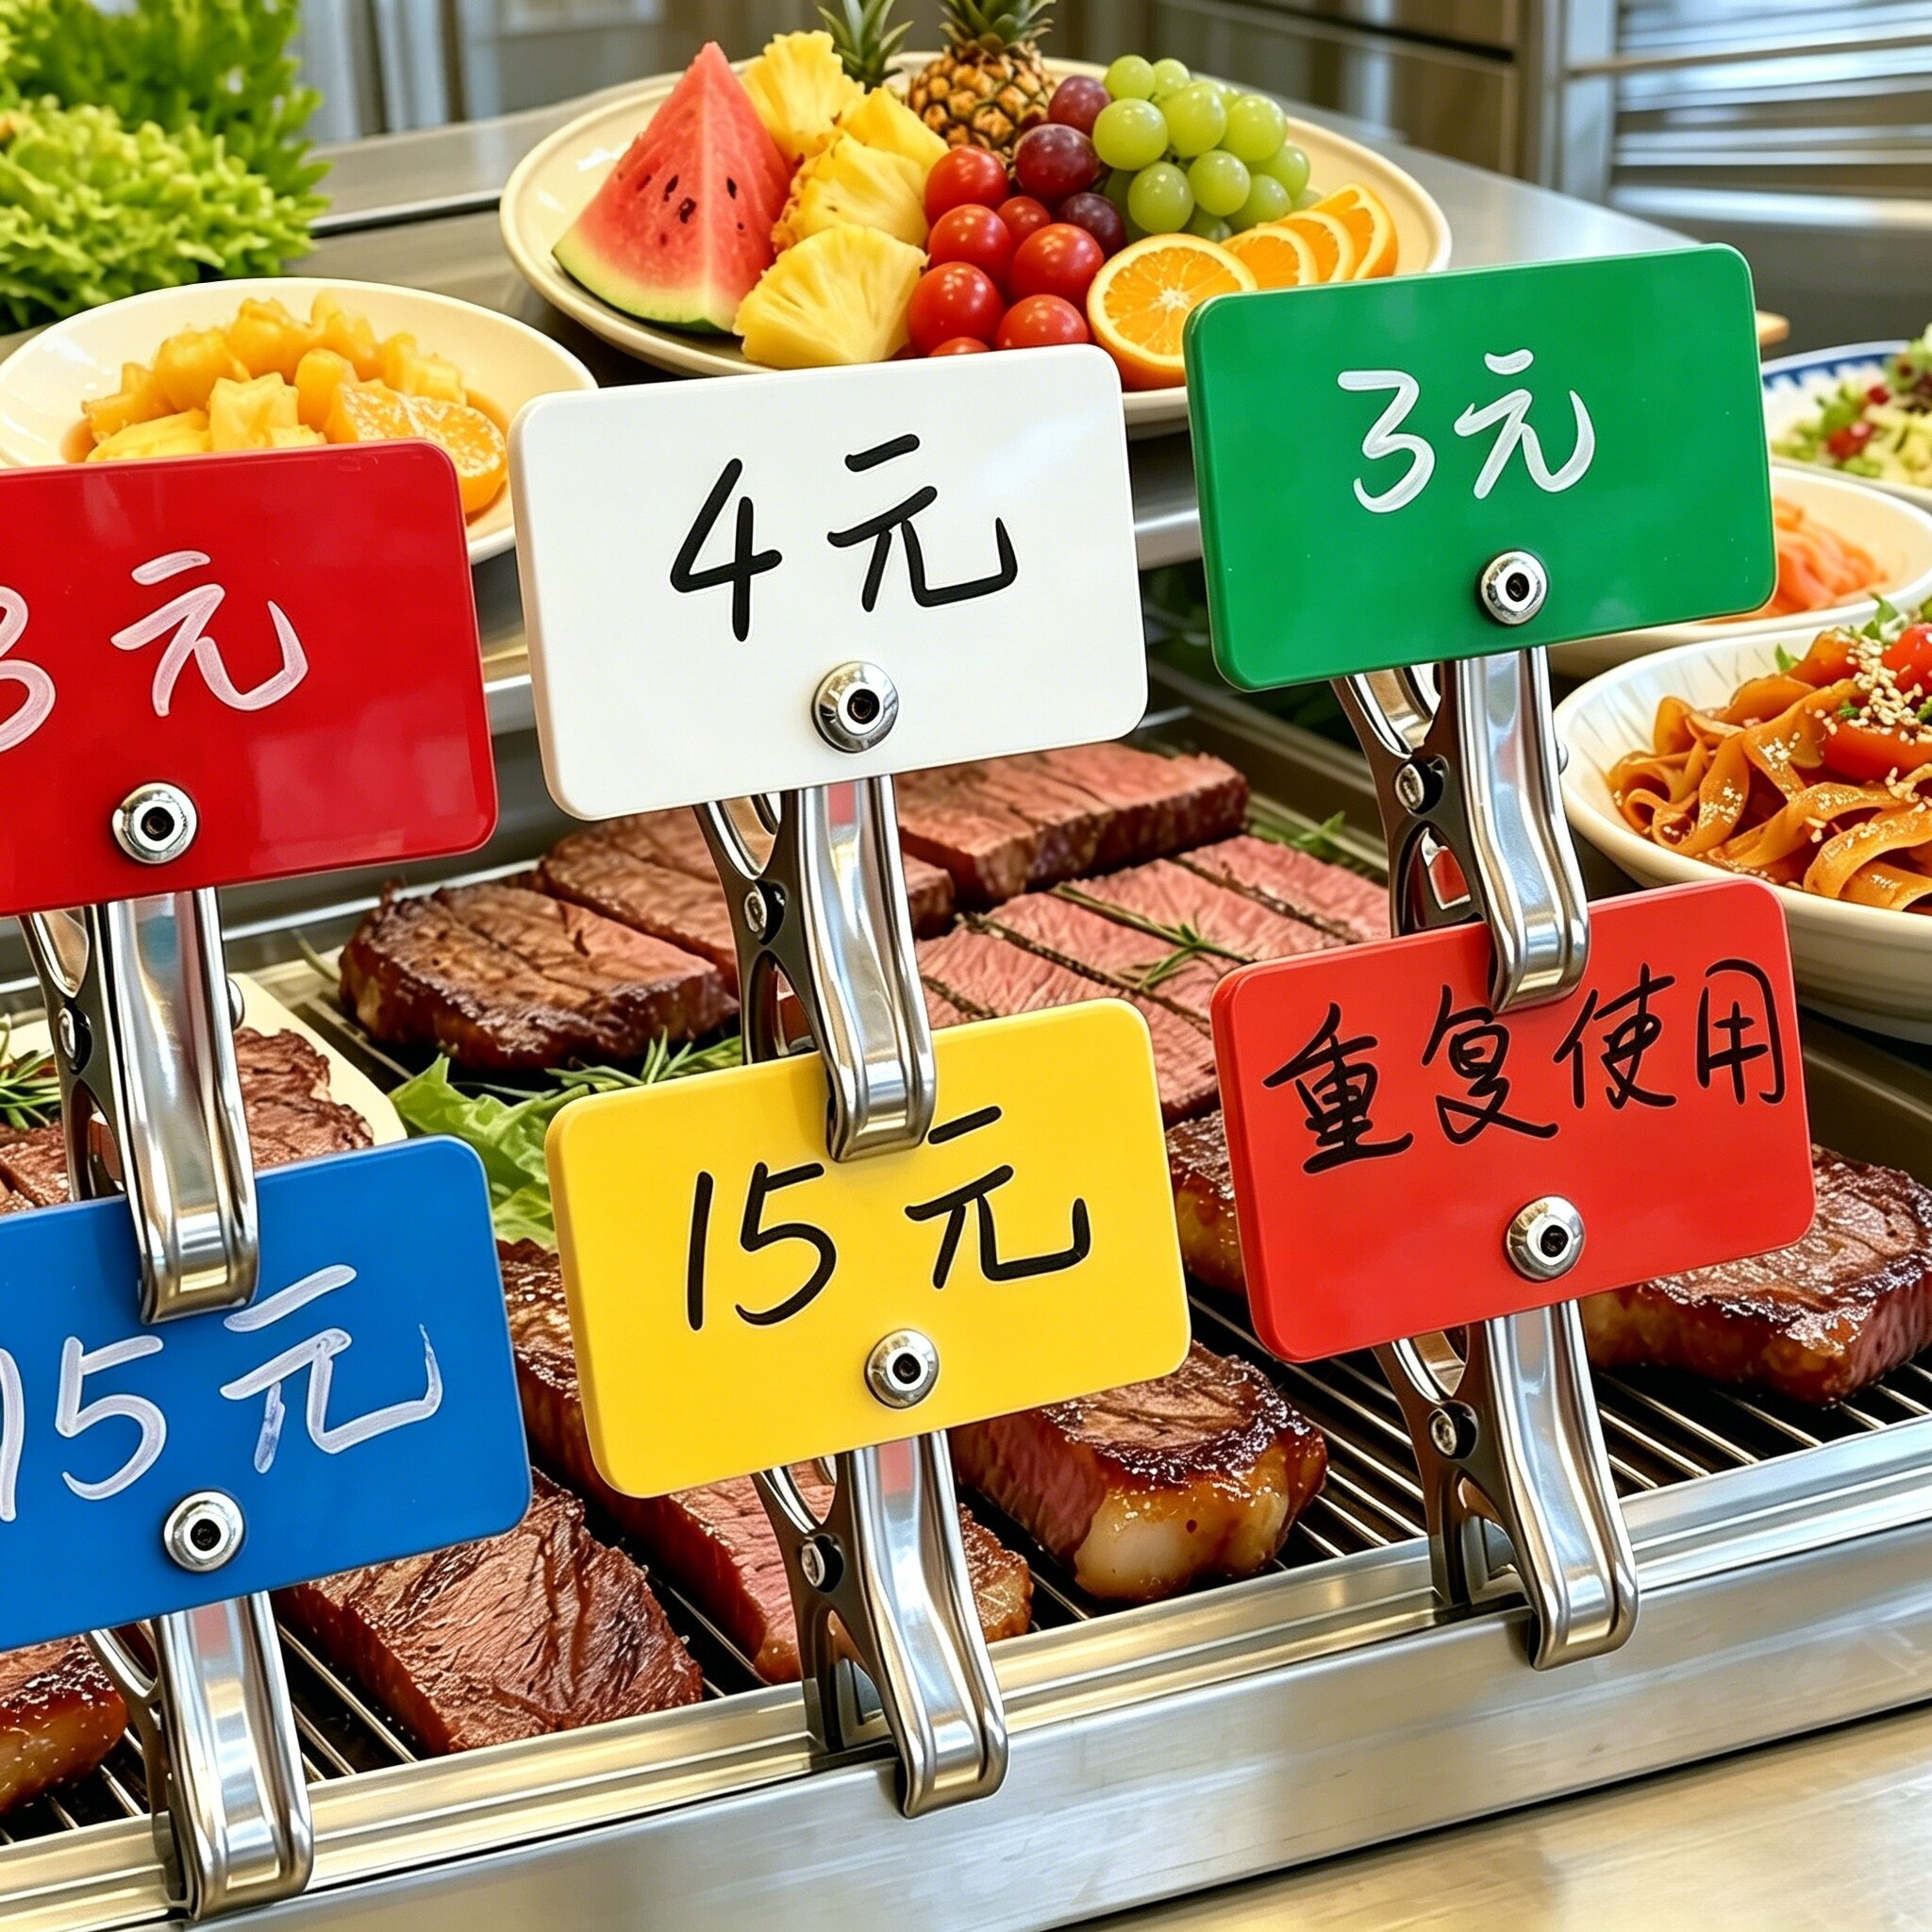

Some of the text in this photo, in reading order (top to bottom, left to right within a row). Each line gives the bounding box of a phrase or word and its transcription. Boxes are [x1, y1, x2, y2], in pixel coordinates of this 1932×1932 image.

[1337, 348, 1596, 513] 3元
[670, 433, 1018, 642] 4元
[1262, 958, 1787, 1175] 重复使用
[687, 1105, 1091, 1331] 15元
